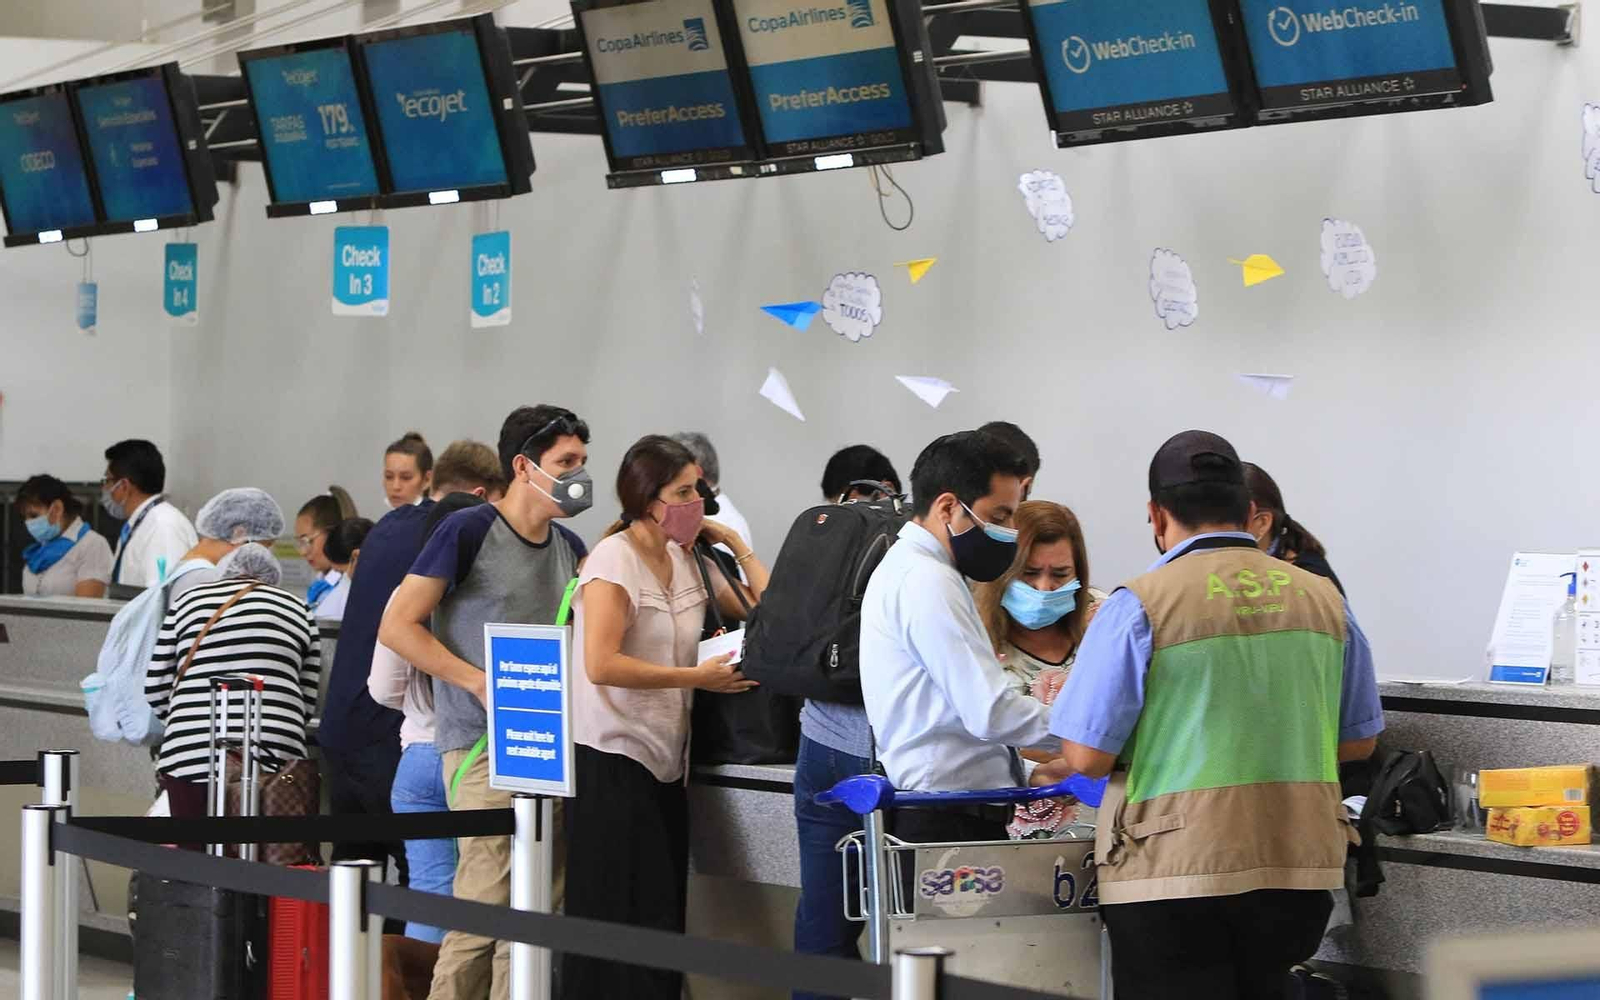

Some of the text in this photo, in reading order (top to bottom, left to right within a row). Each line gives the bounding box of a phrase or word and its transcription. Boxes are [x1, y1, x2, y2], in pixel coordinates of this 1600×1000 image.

[748, 5, 846, 34] CopaAirlines
[1302, 3, 1419, 34] WebCheck-in
[596, 29, 685, 54] CopaAirlines
[1093, 31, 1195, 60] WebCheck-in
[768, 82, 891, 112] PreferAccess
[1300, 77, 1400, 101] STAR ALLIANCE
[404, 88, 468, 123] ecojet
[616, 101, 726, 128] PreferAccess
[1092, 104, 1181, 126] STAR ALLIANCE
[786, 142, 812, 154] STAR
[812, 136, 855, 150] ALLIANCE
[342, 244, 381, 268] Check
[477, 252, 506, 276] Check
[169, 260, 194, 281] Check
[350, 274, 373, 295] In 3
[493, 282, 500, 304] 2
